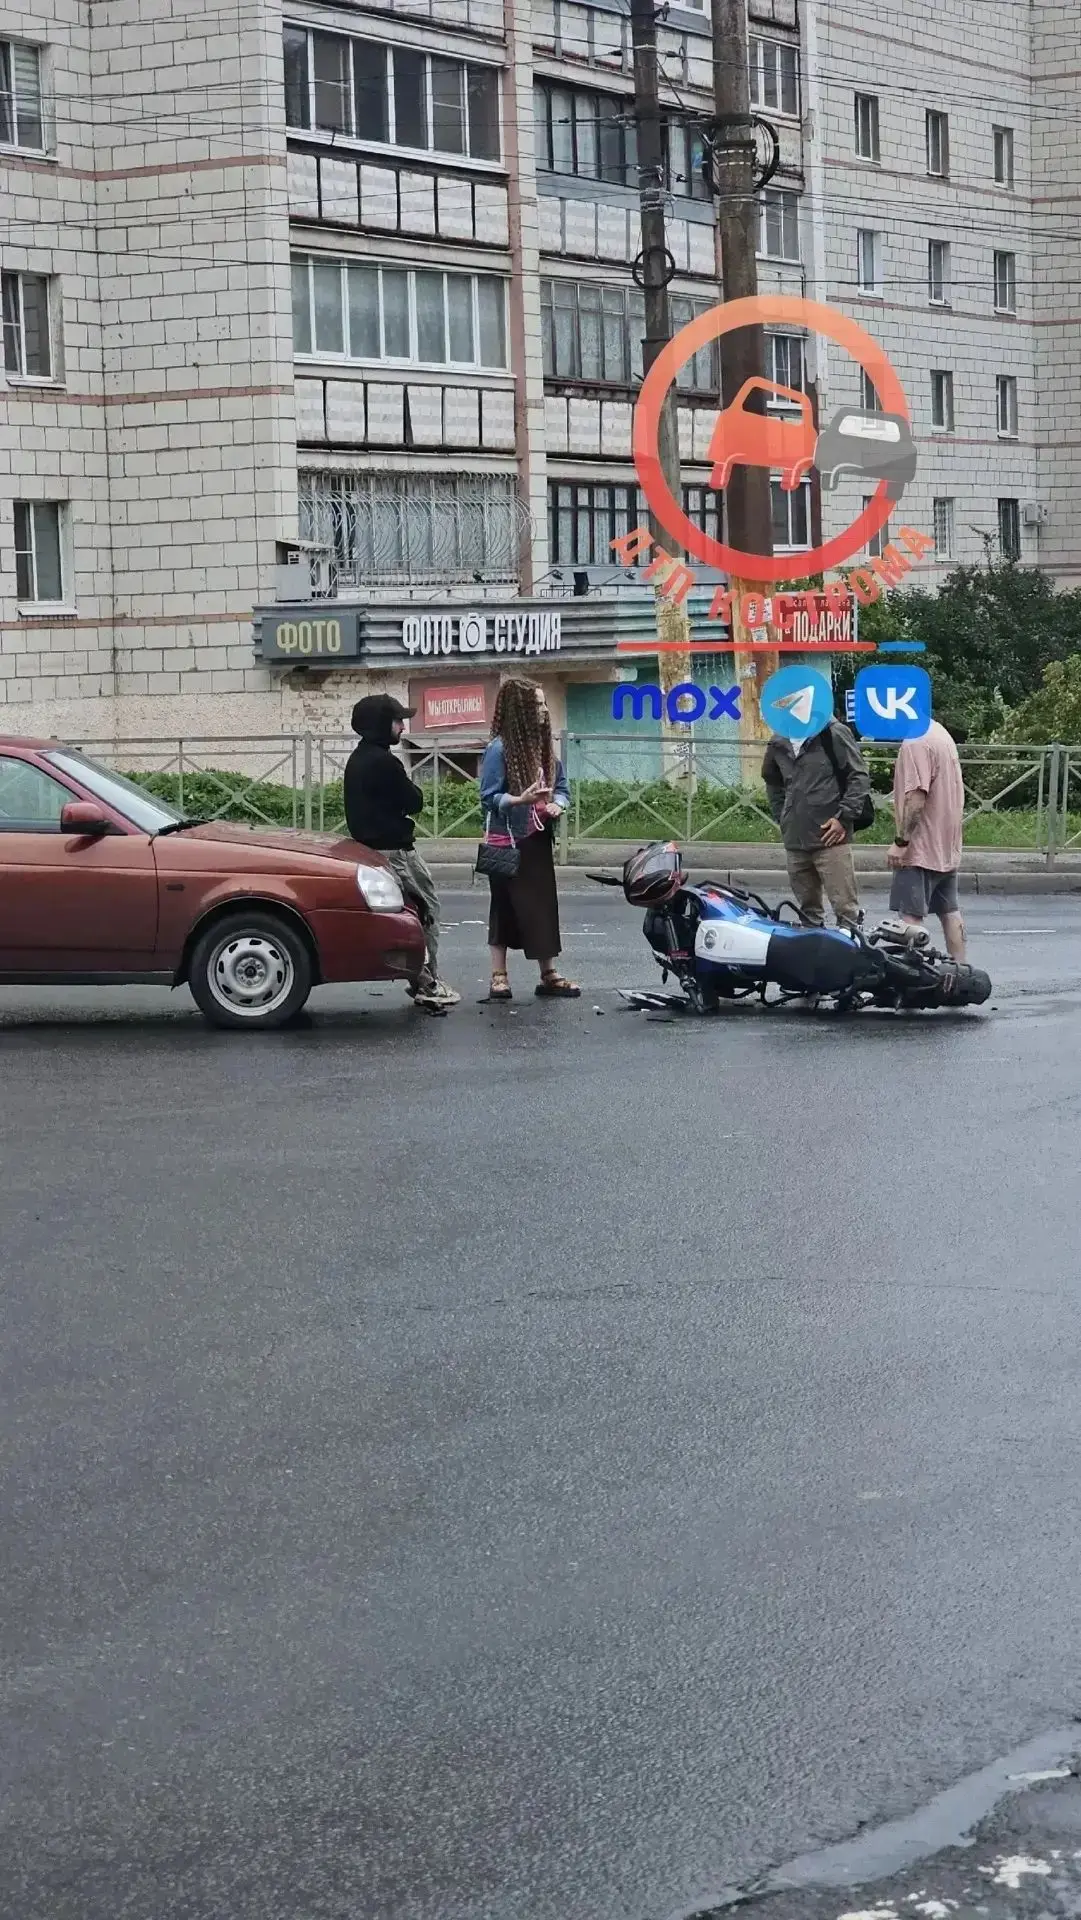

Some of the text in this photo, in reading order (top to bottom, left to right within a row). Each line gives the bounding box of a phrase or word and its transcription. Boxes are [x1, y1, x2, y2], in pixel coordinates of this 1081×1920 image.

[276, 619, 341, 653] ФОТО
[402, 612, 561, 655] ФОТО СТУДИЯ
[793, 611, 851, 642] ПОДАРКИ
